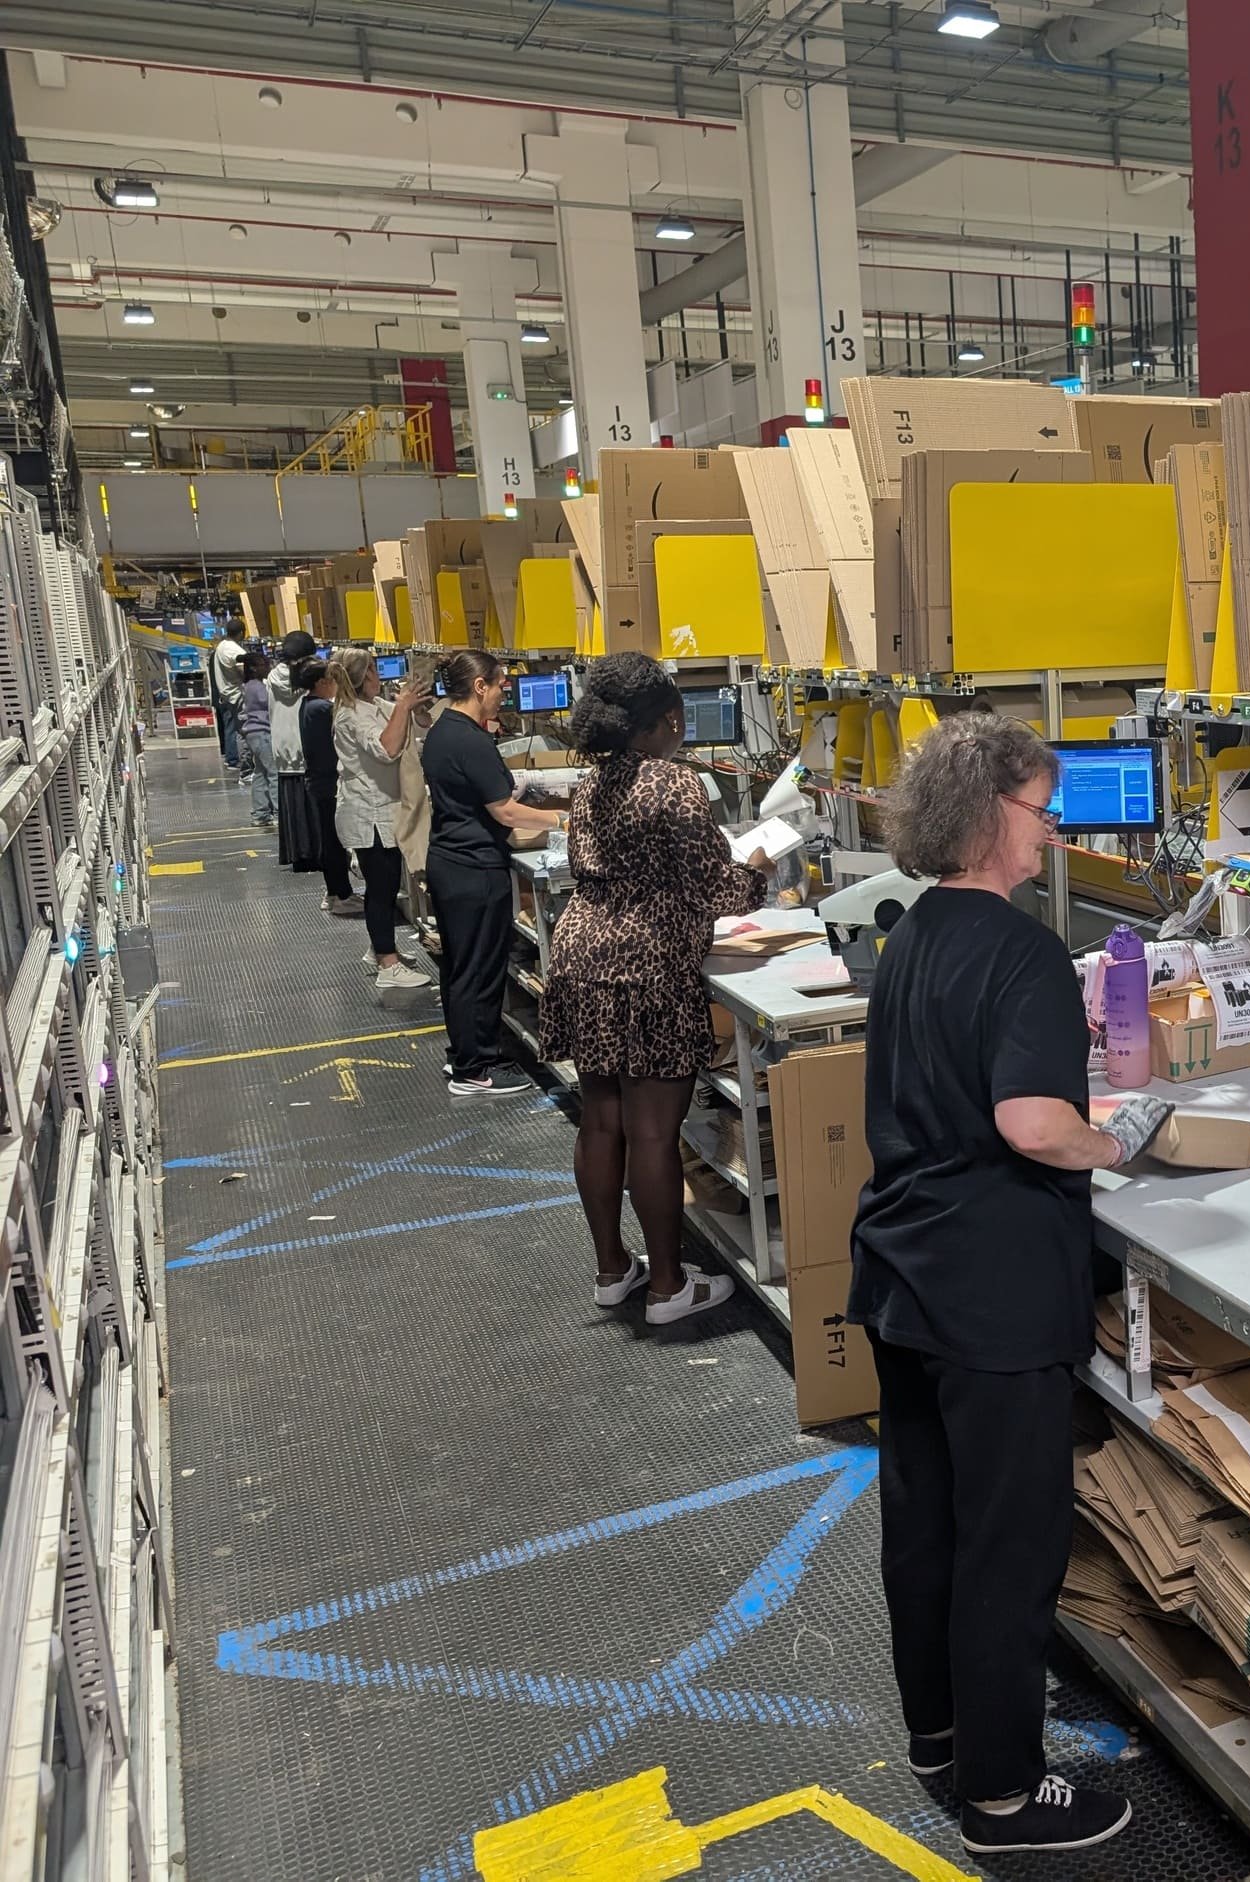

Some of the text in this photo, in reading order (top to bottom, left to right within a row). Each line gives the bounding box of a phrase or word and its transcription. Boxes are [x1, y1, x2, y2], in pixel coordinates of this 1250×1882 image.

[1217, 79, 1236, 125] K
[1214, 126, 1241, 176] 13
[830, 310, 845, 334] J
[767, 337, 779, 363] 13
[825, 337, 856, 362] 13
[615, 405, 621, 422] I
[608, 424, 632, 442] 13
[893, 410, 914, 445] F13
[504, 457, 515, 471] H
[502, 472, 521, 486] 13
[1091, 1050, 1108, 1059] UN3
[827, 1330, 846, 1368] F17
